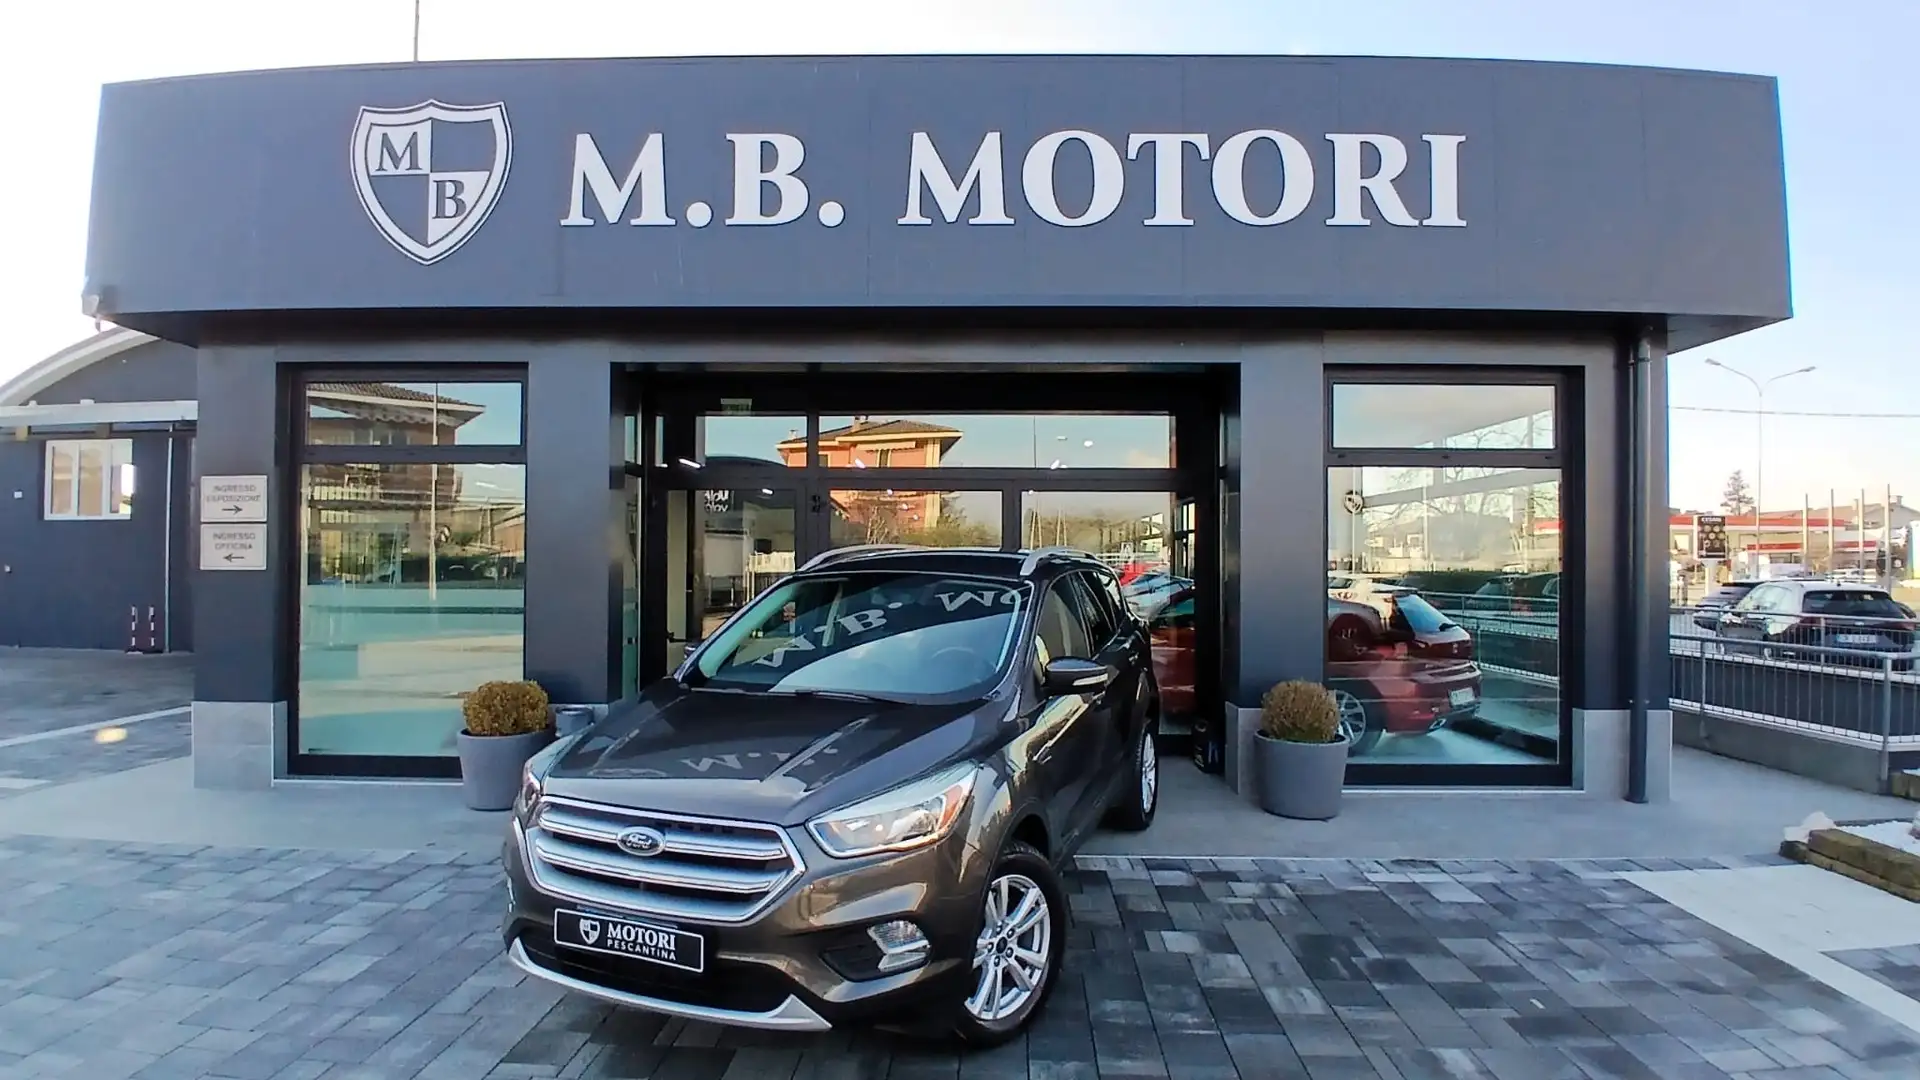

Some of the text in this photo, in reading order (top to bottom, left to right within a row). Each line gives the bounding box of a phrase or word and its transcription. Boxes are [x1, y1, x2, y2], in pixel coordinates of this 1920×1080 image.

[376, 131, 423, 172] M
[560, 129, 1468, 228] M.B. MOTORI
[432, 179, 467, 219] B
[607, 922, 676, 950] MOTORI
[607, 939, 676, 961] PESCANTINA
